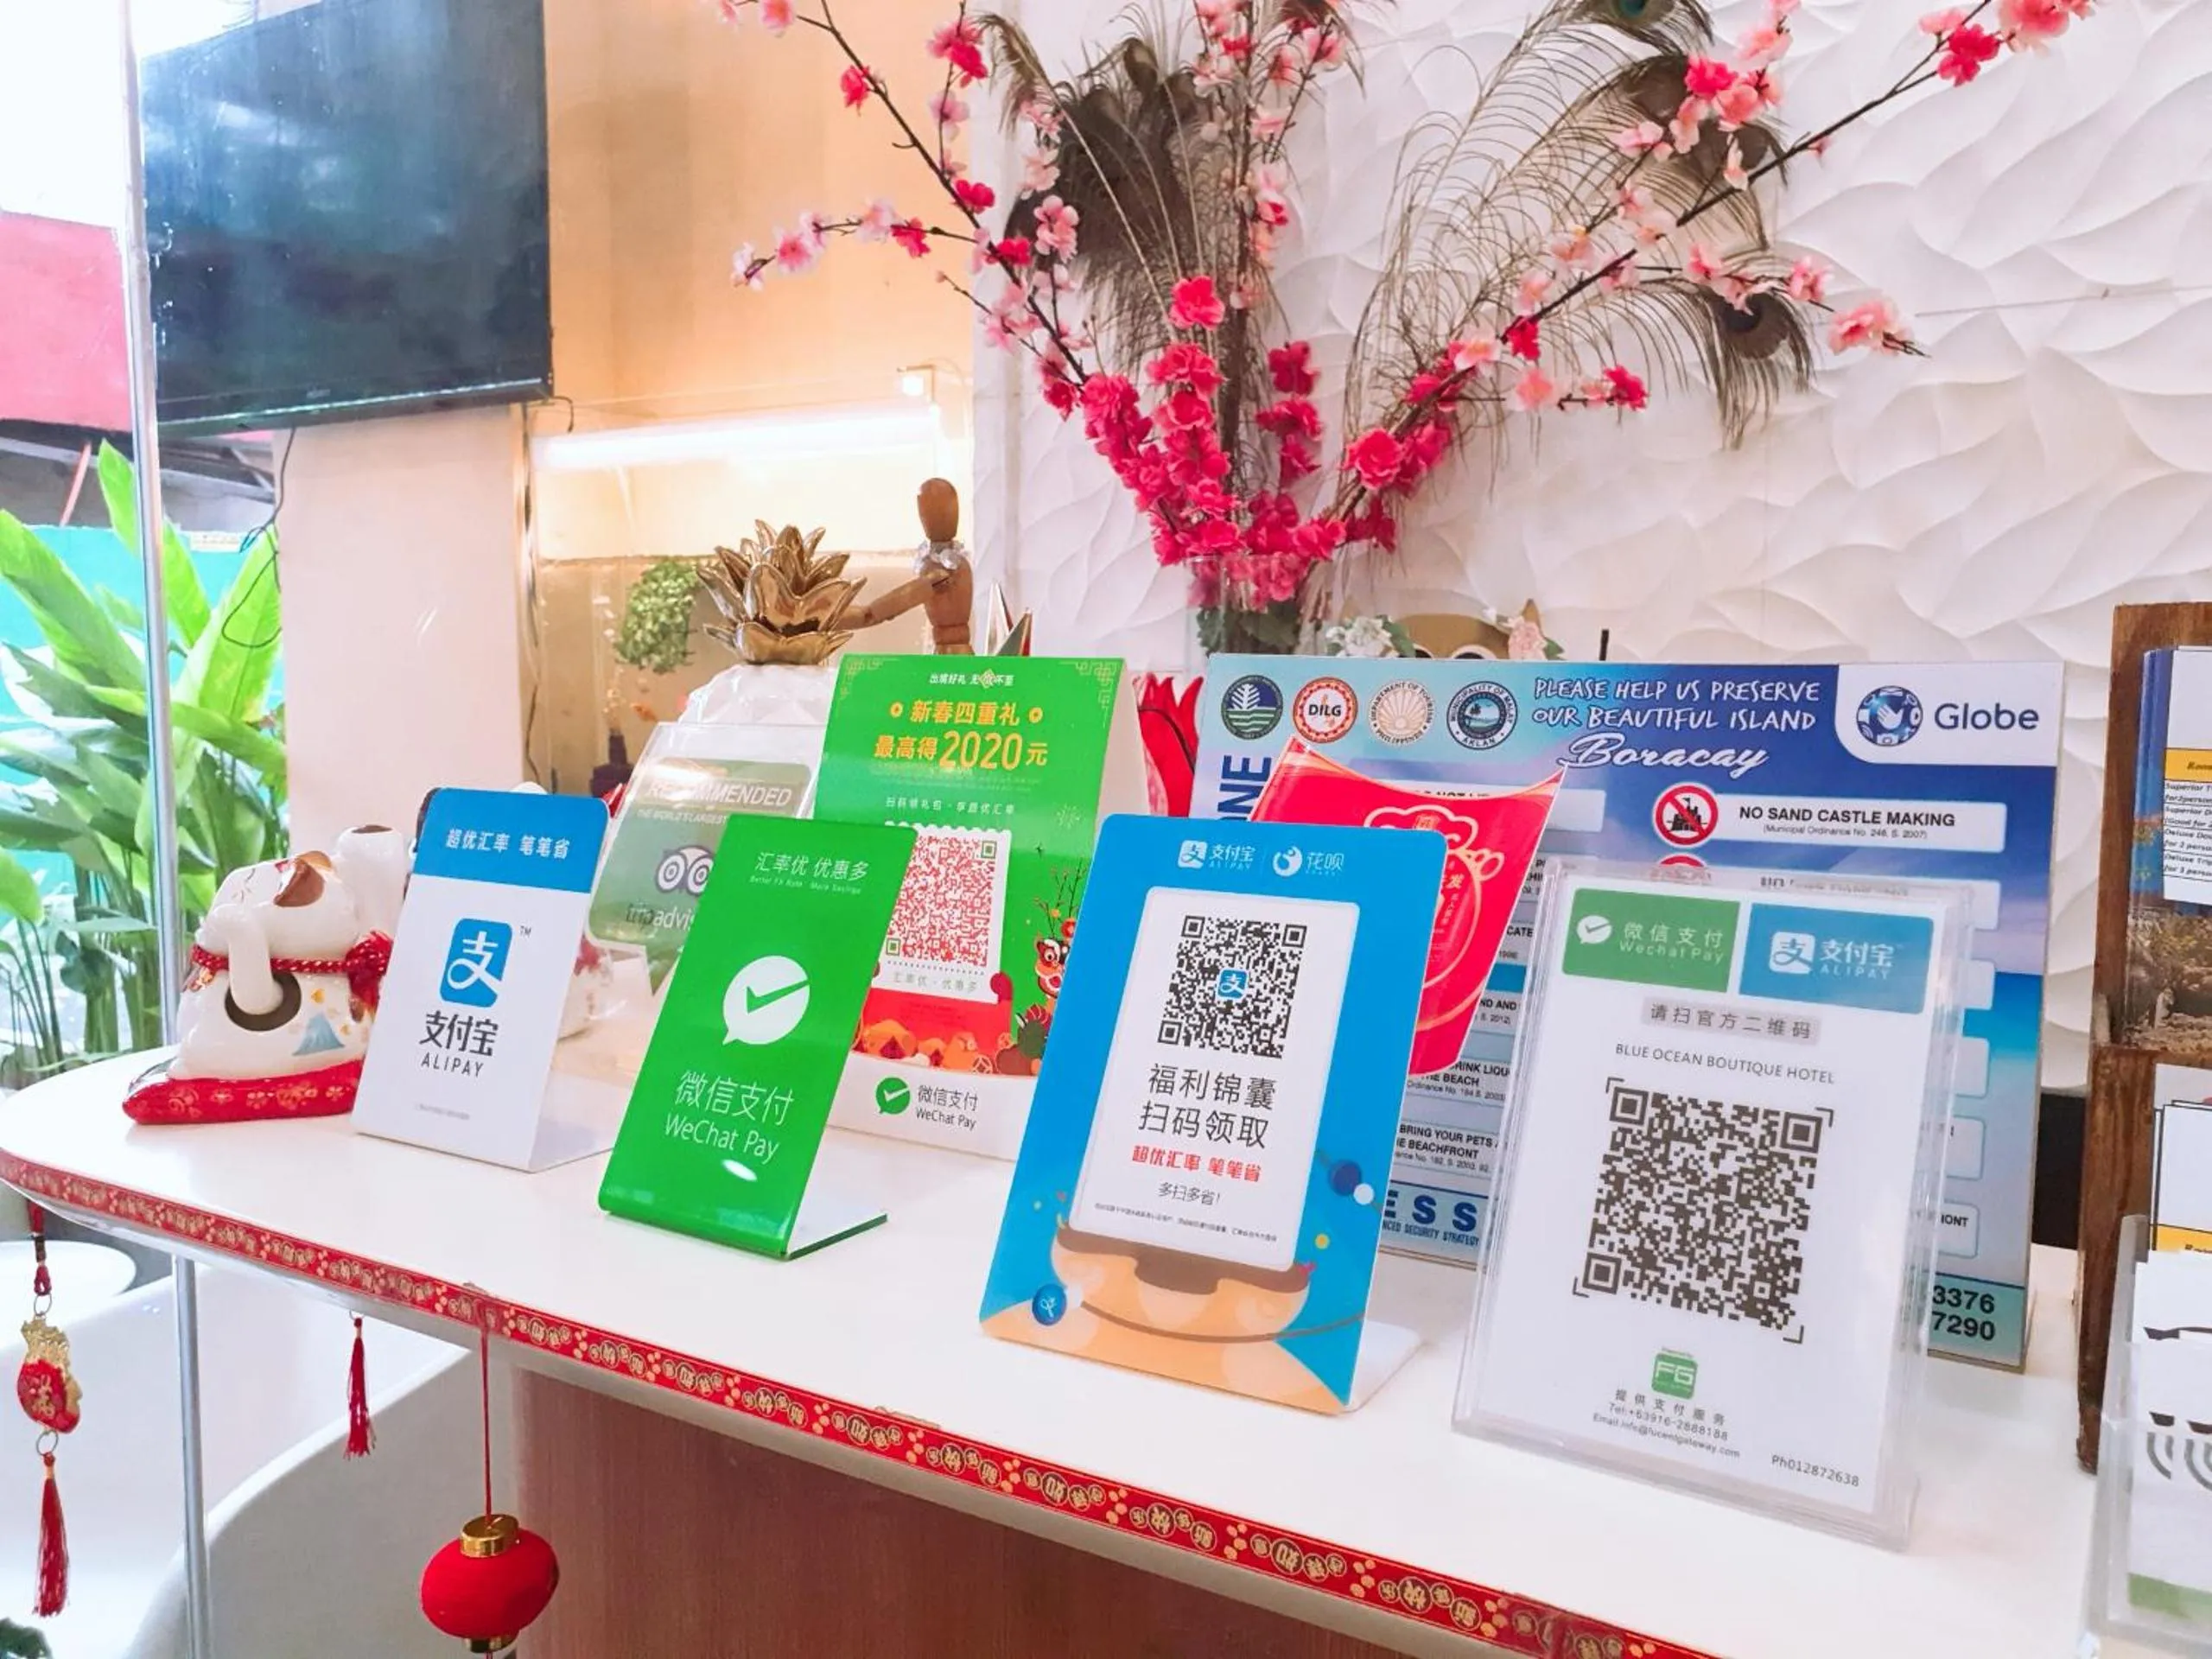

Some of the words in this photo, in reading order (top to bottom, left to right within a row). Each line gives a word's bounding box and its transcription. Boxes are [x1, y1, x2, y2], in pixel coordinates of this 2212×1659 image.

[1534, 677, 1607, 702] PLEASE
[1615, 680, 1668, 702] HELP
[1675, 680, 1700, 702] US
[1710, 680, 1821, 702] PRESERVE
[910, 700, 1020, 726] 新春四重礼
[1308, 704, 1342, 717] DILG
[1532, 706, 1581, 728] OUR
[1587, 706, 1719, 730] BEAUTIFUL
[1729, 709, 1816, 732] ISLAND
[1934, 702, 2040, 733] Globe
[1463, 737, 1496, 748] AKLAN
[1558, 732, 1770, 779] Boracay
[1738, 806, 1764, 820] NO
[1768, 807, 1812, 822] SAND
[1817, 809, 1882, 825] CASTLE
[1886, 811, 1956, 827] MAKING
[445, 829, 510, 854] 超优汇率
[518, 836, 570, 860] 笔笔省
[1211, 844, 1256, 862] 支付宝
[755, 852, 809, 875] 汇率优
[813, 857, 869, 881] 优惠多
[1624, 921, 1725, 950] 微信支付
[1821, 938, 1896, 969] 支付宝
[1820, 964, 1891, 979] ALIPAY
[1496, 1000, 1516, 1011] AND
[419, 1010, 499, 1057] 支付宝
[1650, 1002, 1812, 1039] 请扫官方二维码
[421, 1052, 485, 1077] ALIPAY
[1483, 1064, 1510, 1077] LIQU
[1615, 1043, 1649, 1059] BLUE
[1652, 1047, 1702, 1066] OCEAN
[1707, 1055, 1782, 1078] BOUTIQUE
[1787, 1067, 1835, 1084] HOTEL
[1147, 1063, 1278, 1110] 福利锦囊
[1443, 1073, 1480, 1087] BEACH
[675, 1070, 795, 1126] 微信支付
[918, 1084, 978, 1111] 微信支付
[916, 1107, 955, 1124] WeChat
[957, 1114, 977, 1131] Pay
[1137, 1100, 1269, 1150] 扫码领取
[664, 1113, 739, 1151] WeChat
[743, 1130, 780, 1165] Pay
[1399, 1124, 1432, 1138] BRING
[1434, 1129, 1464, 1143] YOUR
[1466, 1135, 1493, 1148] PETS
[1408, 1139, 1480, 1160] BEACHFRONT
[1131, 1145, 1202, 1173] 超优汇率
[1207, 1156, 1262, 1183] 笔笔省
[1404, 1224, 1440, 1239] SECURITY
[1443, 1230, 1480, 1246] STRATEGY
[1931, 1310, 1996, 1341] 7290
